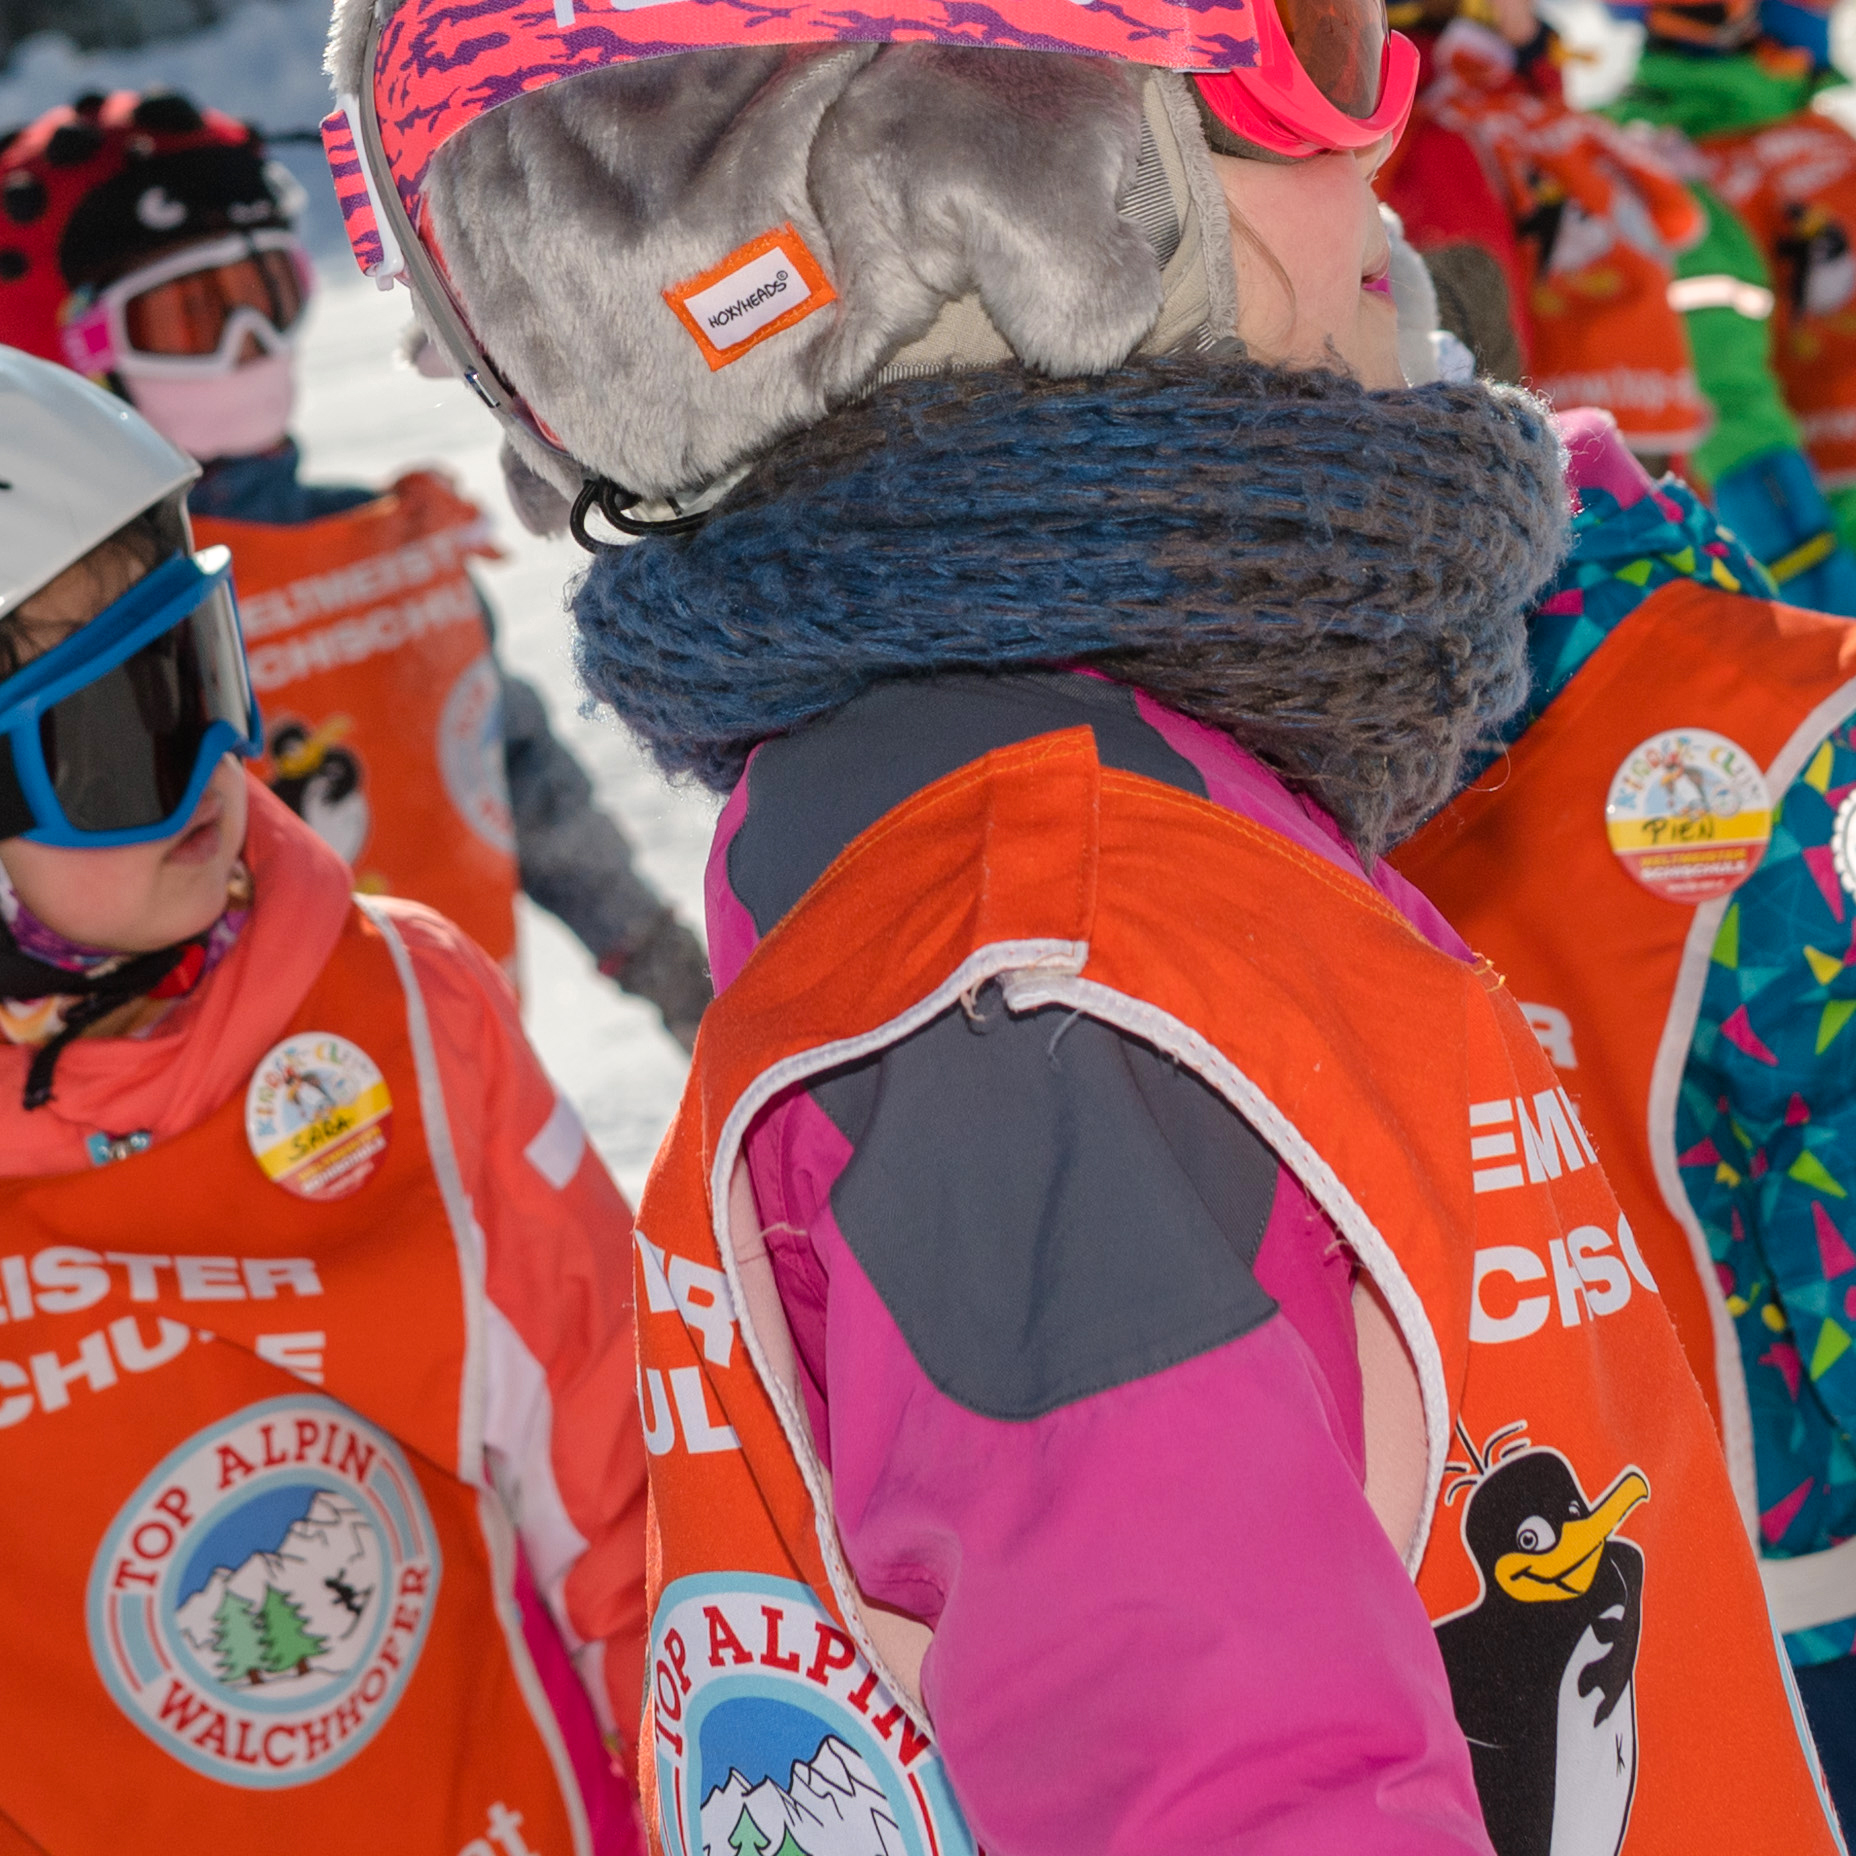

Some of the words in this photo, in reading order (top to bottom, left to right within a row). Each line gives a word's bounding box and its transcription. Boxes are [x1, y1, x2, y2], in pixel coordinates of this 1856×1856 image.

[1642, 816, 1714, 844] PIEN
[114, 1485, 194, 1593] TOP
[214, 1419, 376, 1490] ALPIN
[156, 1563, 431, 1767] WALCHHOFER
[654, 1627, 692, 1758] TOP
[702, 1604, 932, 1767] ALPIN
